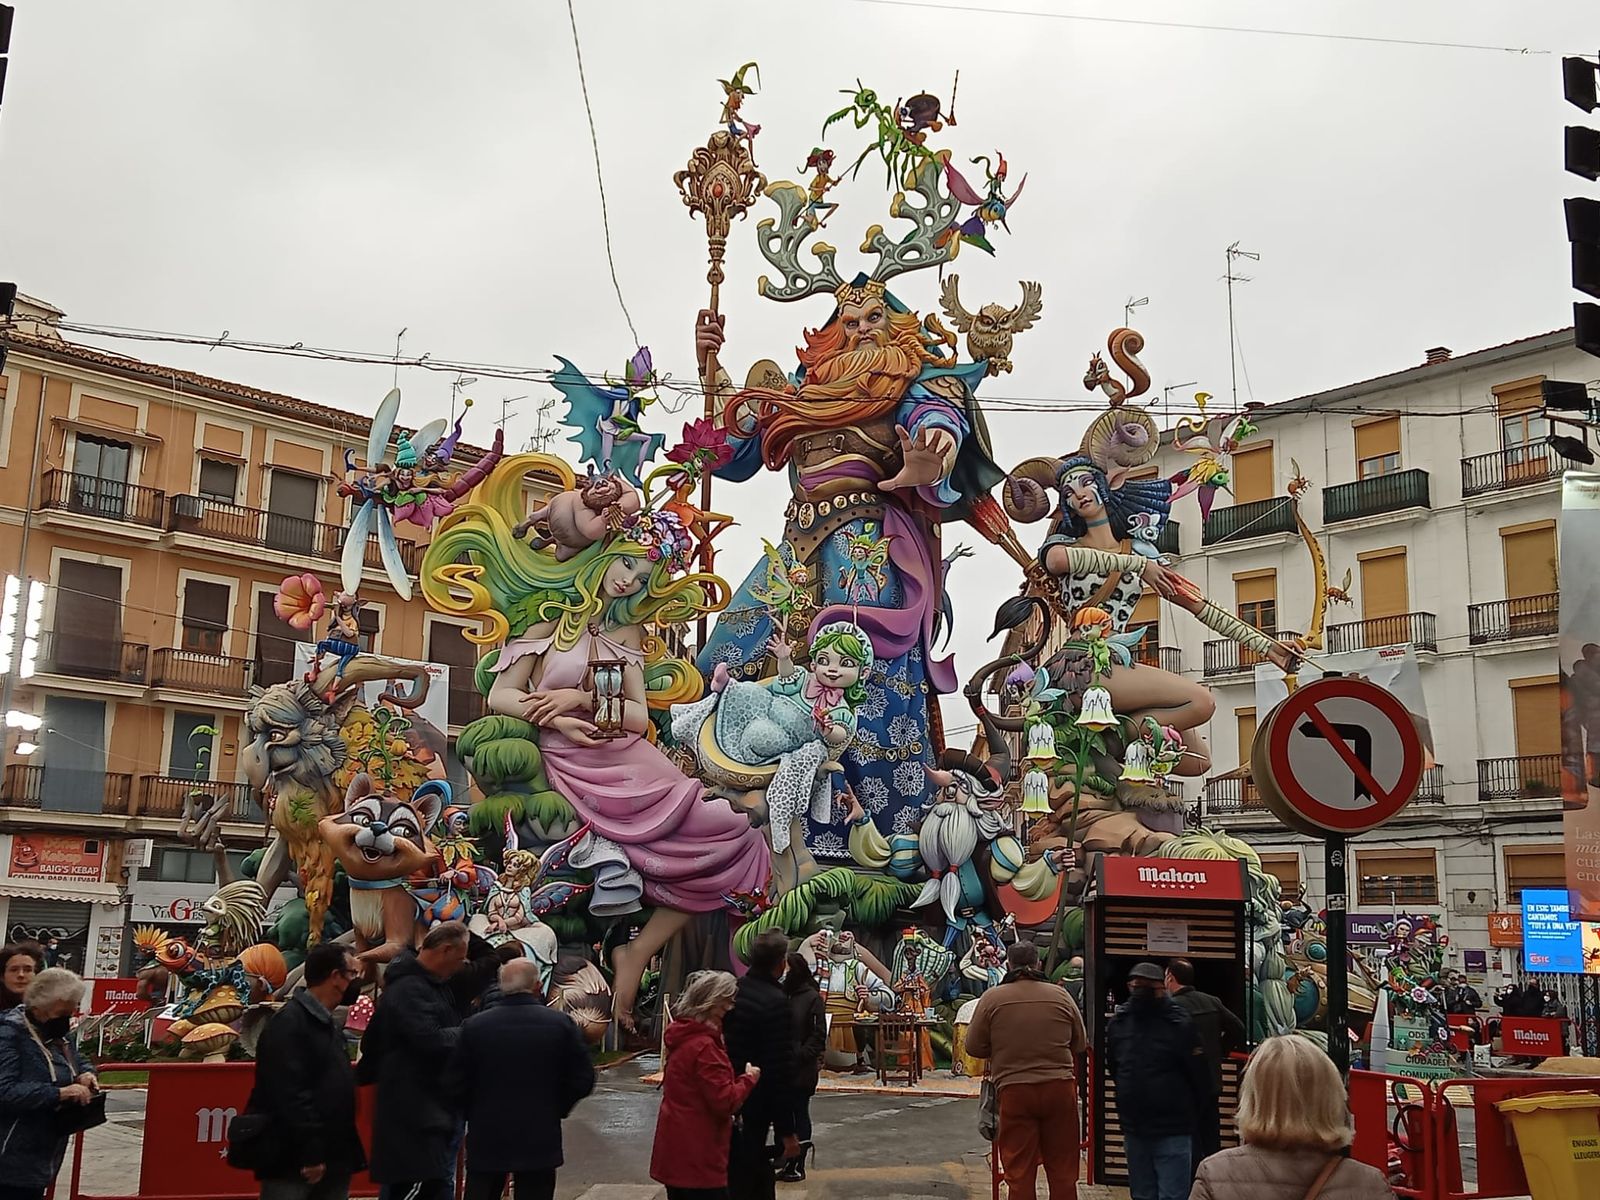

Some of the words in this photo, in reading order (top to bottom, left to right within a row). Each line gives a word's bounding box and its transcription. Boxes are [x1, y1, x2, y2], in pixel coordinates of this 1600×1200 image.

[1575, 827, 1600, 840] Las
[40, 864, 69, 874] BAIG'S
[71, 866, 99, 875] KEBAP
[1137, 867, 1208, 884] Mahou
[1408, 1031, 1426, 1039] ODS
[1513, 1029, 1549, 1041] Mahou
